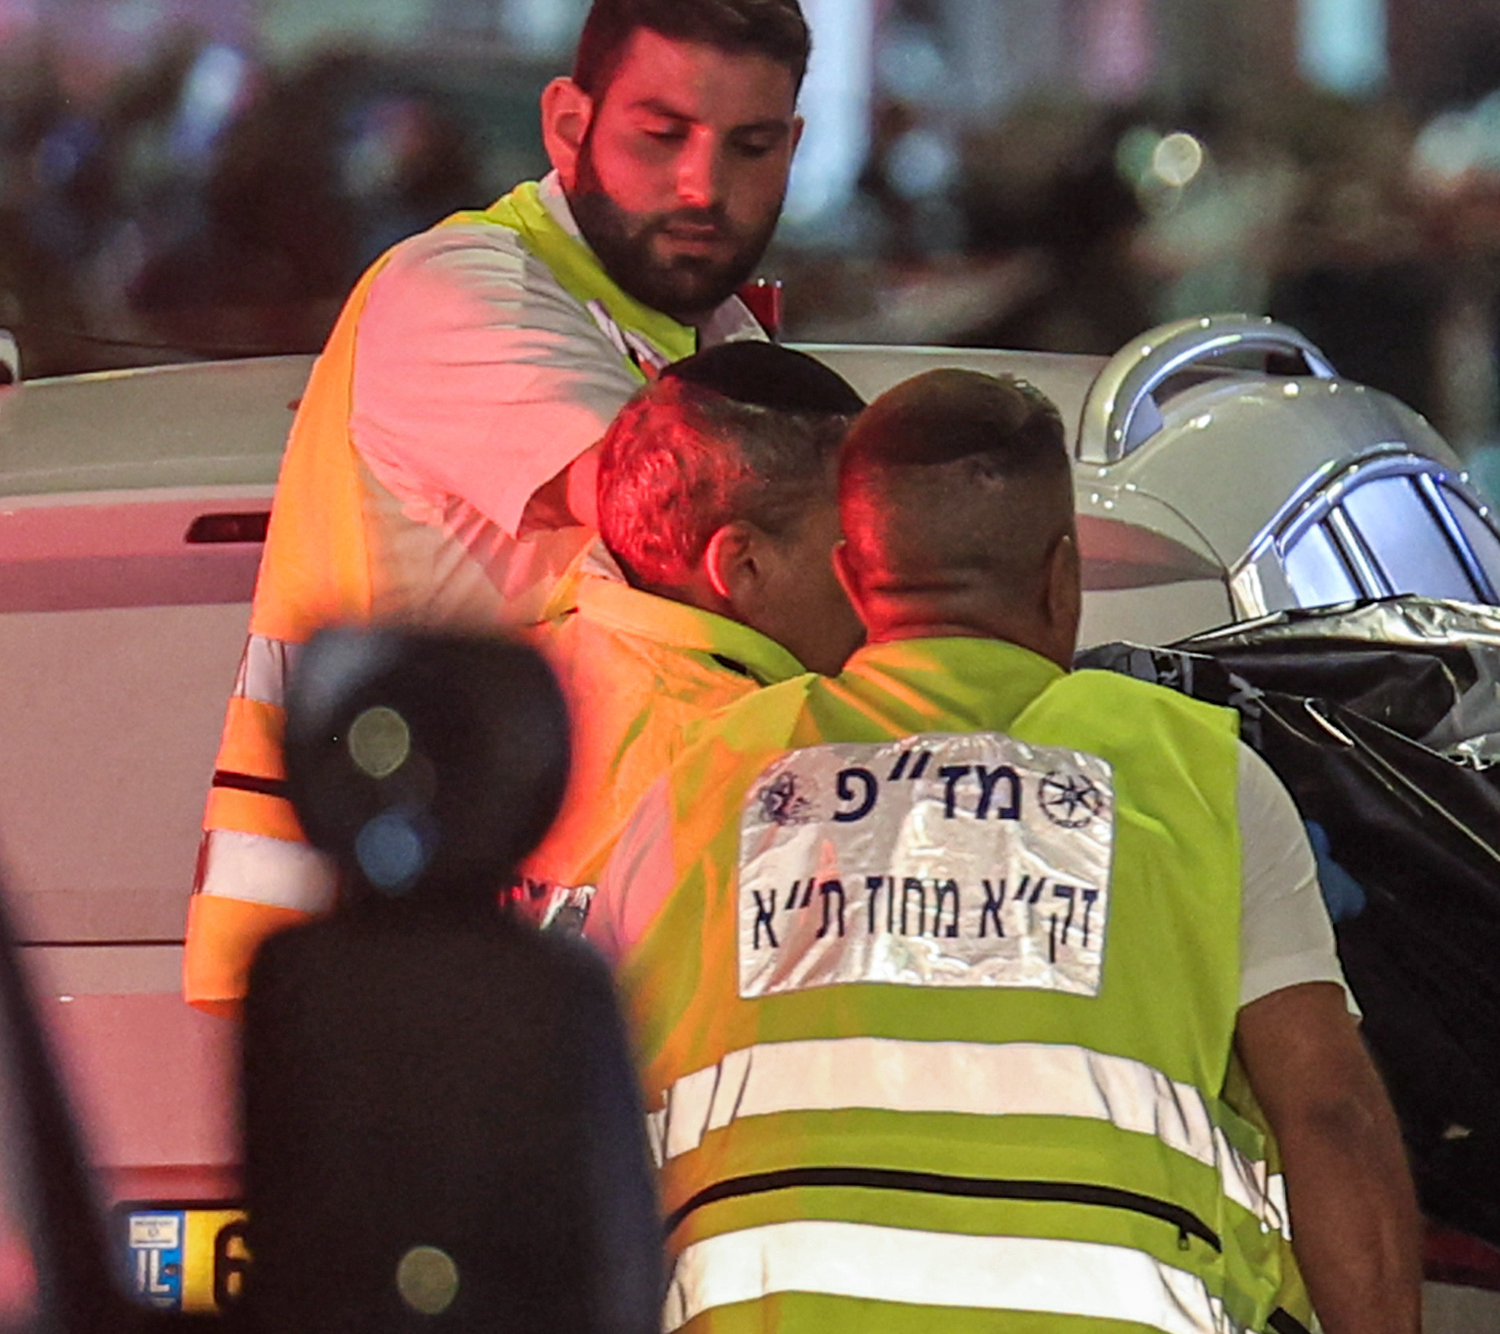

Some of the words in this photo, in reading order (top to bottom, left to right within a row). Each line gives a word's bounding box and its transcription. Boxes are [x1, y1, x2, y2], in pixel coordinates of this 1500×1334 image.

[832, 751, 1022, 823] מז"פ
[752, 876, 845, 950] ת"א
[865, 875, 960, 939] מחוז
[979, 876, 1098, 964] זק"א
[137, 1248, 170, 1293] IL
